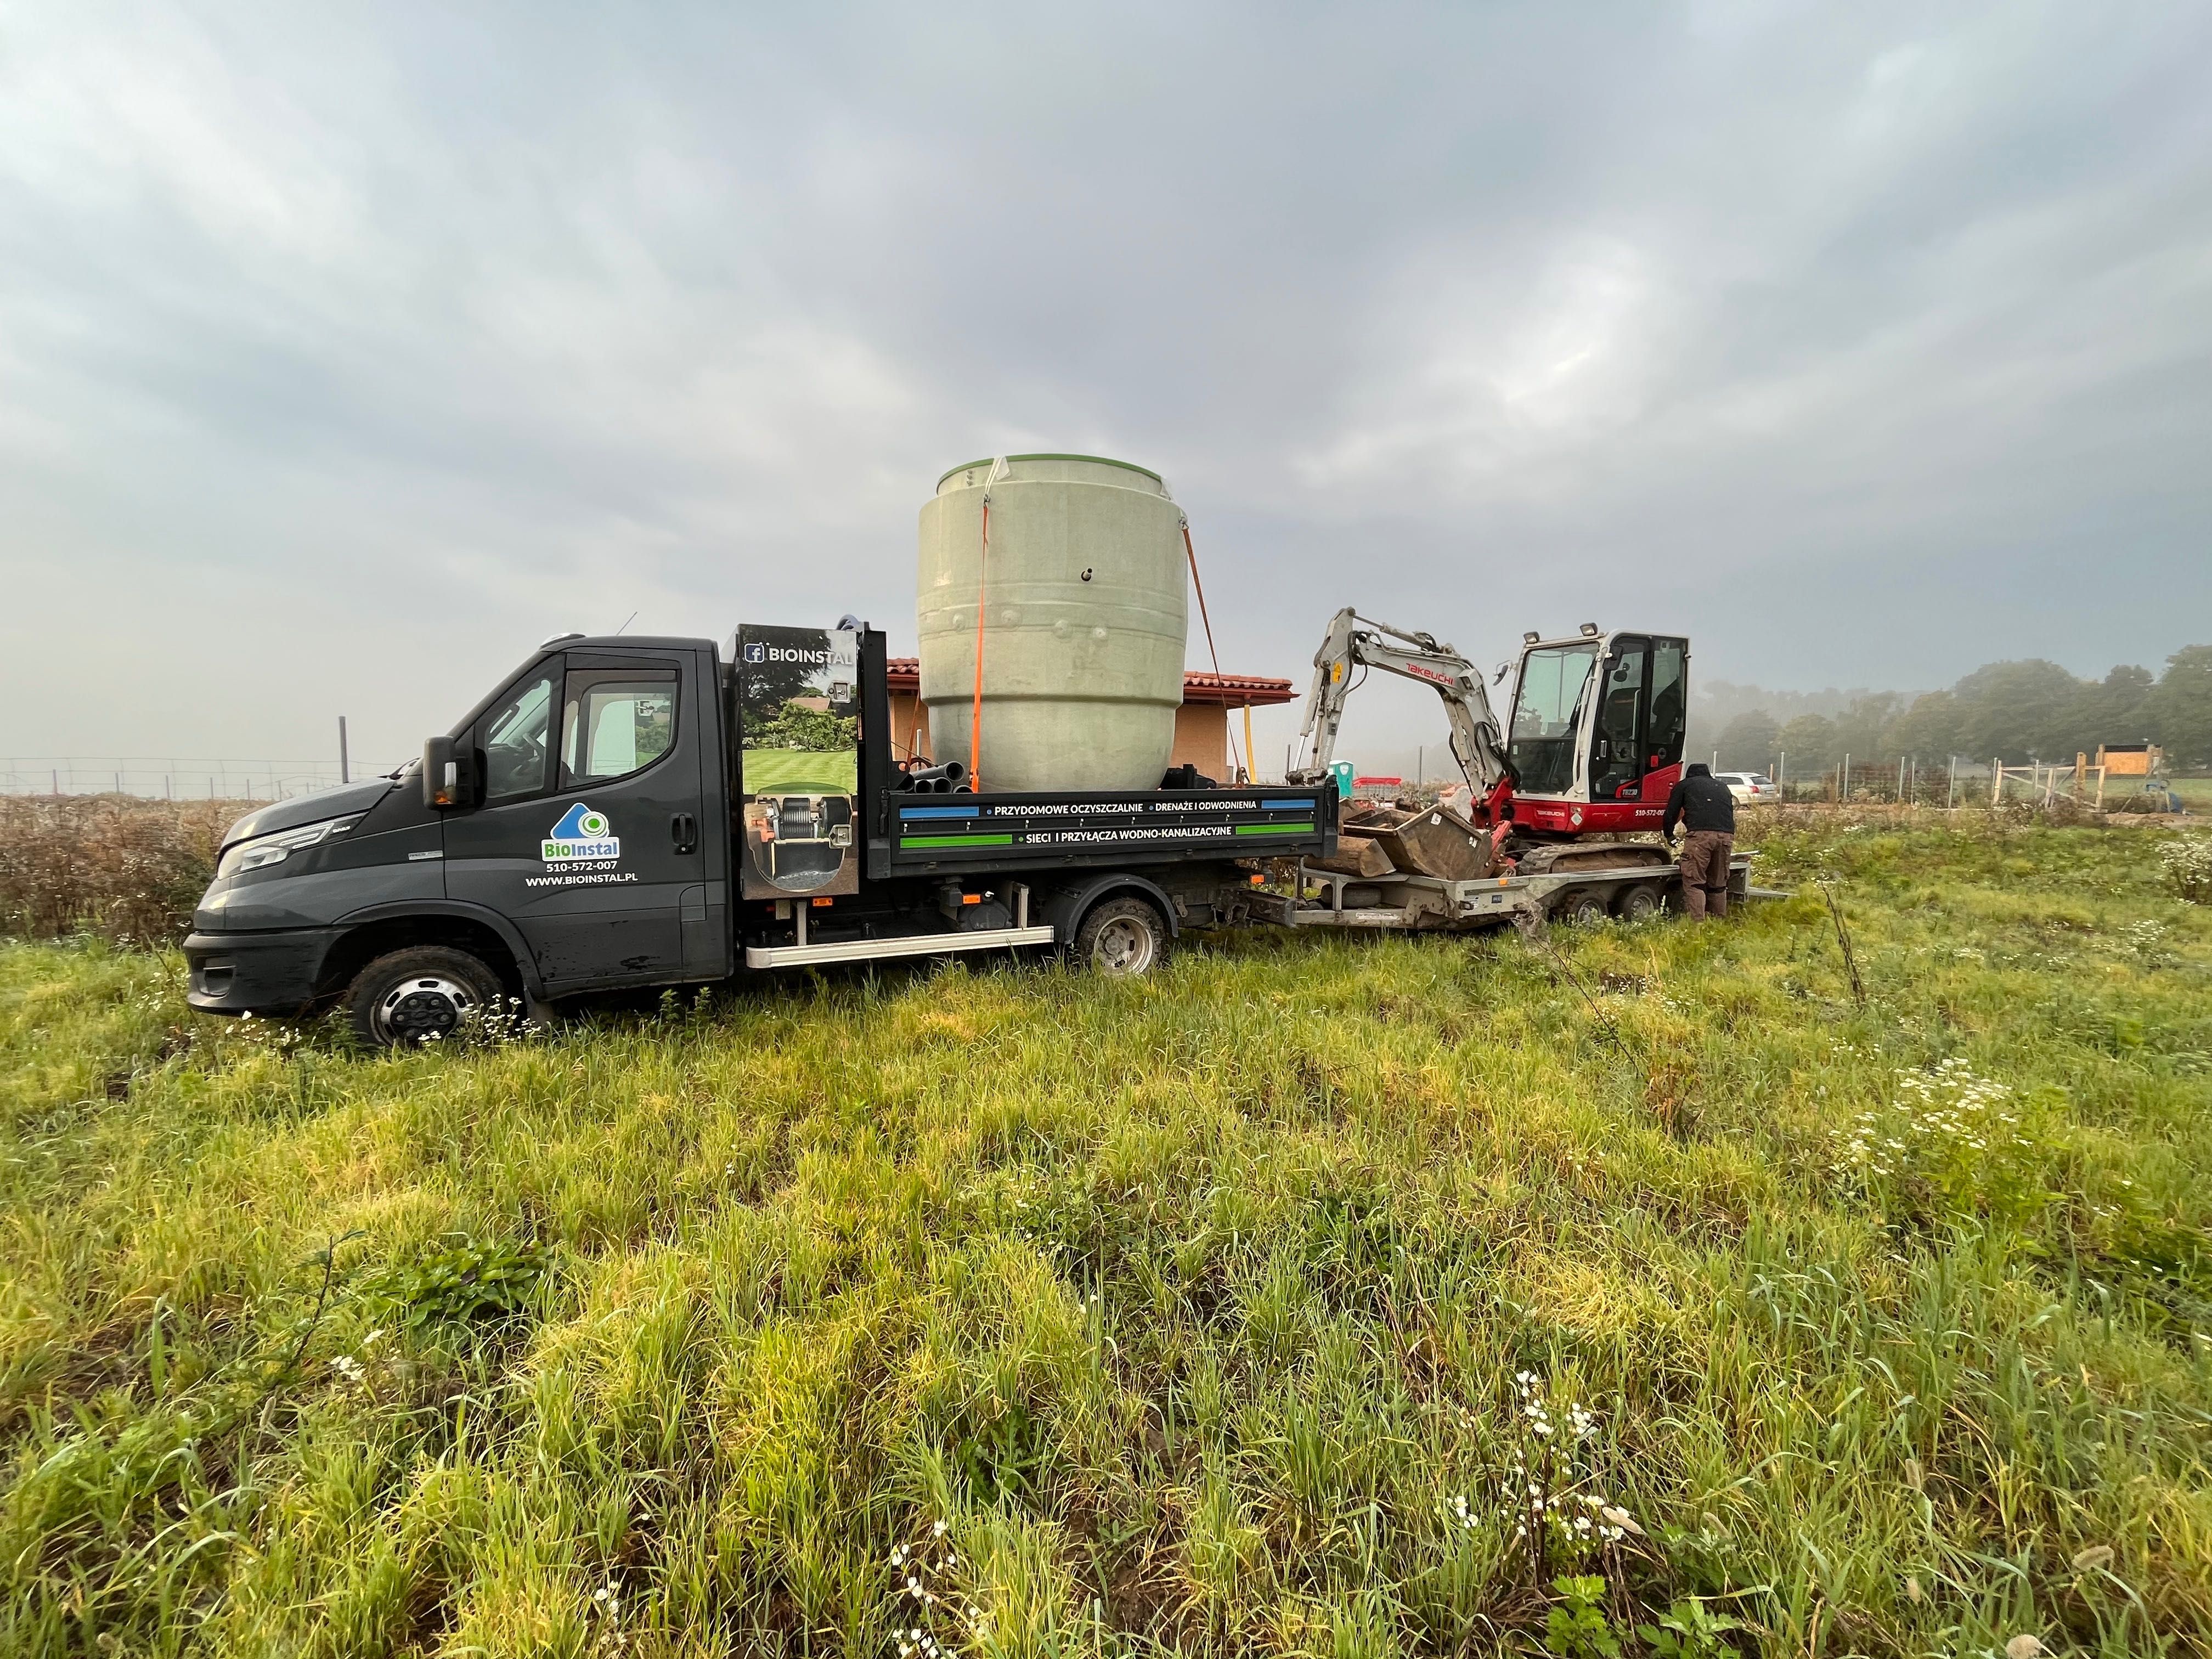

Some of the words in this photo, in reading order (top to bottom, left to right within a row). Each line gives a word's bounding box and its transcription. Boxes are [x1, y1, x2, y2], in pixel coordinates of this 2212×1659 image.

[769, 648, 853, 664] BIOINSTAL
[994, 805, 1069, 815] PRZYDOMOWE
[1070, 803, 1143, 814] OCZYSZCZALNIE
[1155, 801, 1193, 811] DRENAŻE
[1194, 802, 1198, 810] I
[1199, 801, 1257, 810] ODWODNIENIA
[1026, 833, 1051, 844] SIECI
[1056, 832, 1059, 842] I
[1061, 831, 1118, 843] PRZYŁĄCZA
[1119, 826, 1232, 840] WODNO-KANALIZACYJNE
[544, 842, 617, 857] BioInstal
[546, 861, 618, 872] 510-572-007
[525, 873, 639, 887] WWW.BIOINSTAL.PL
